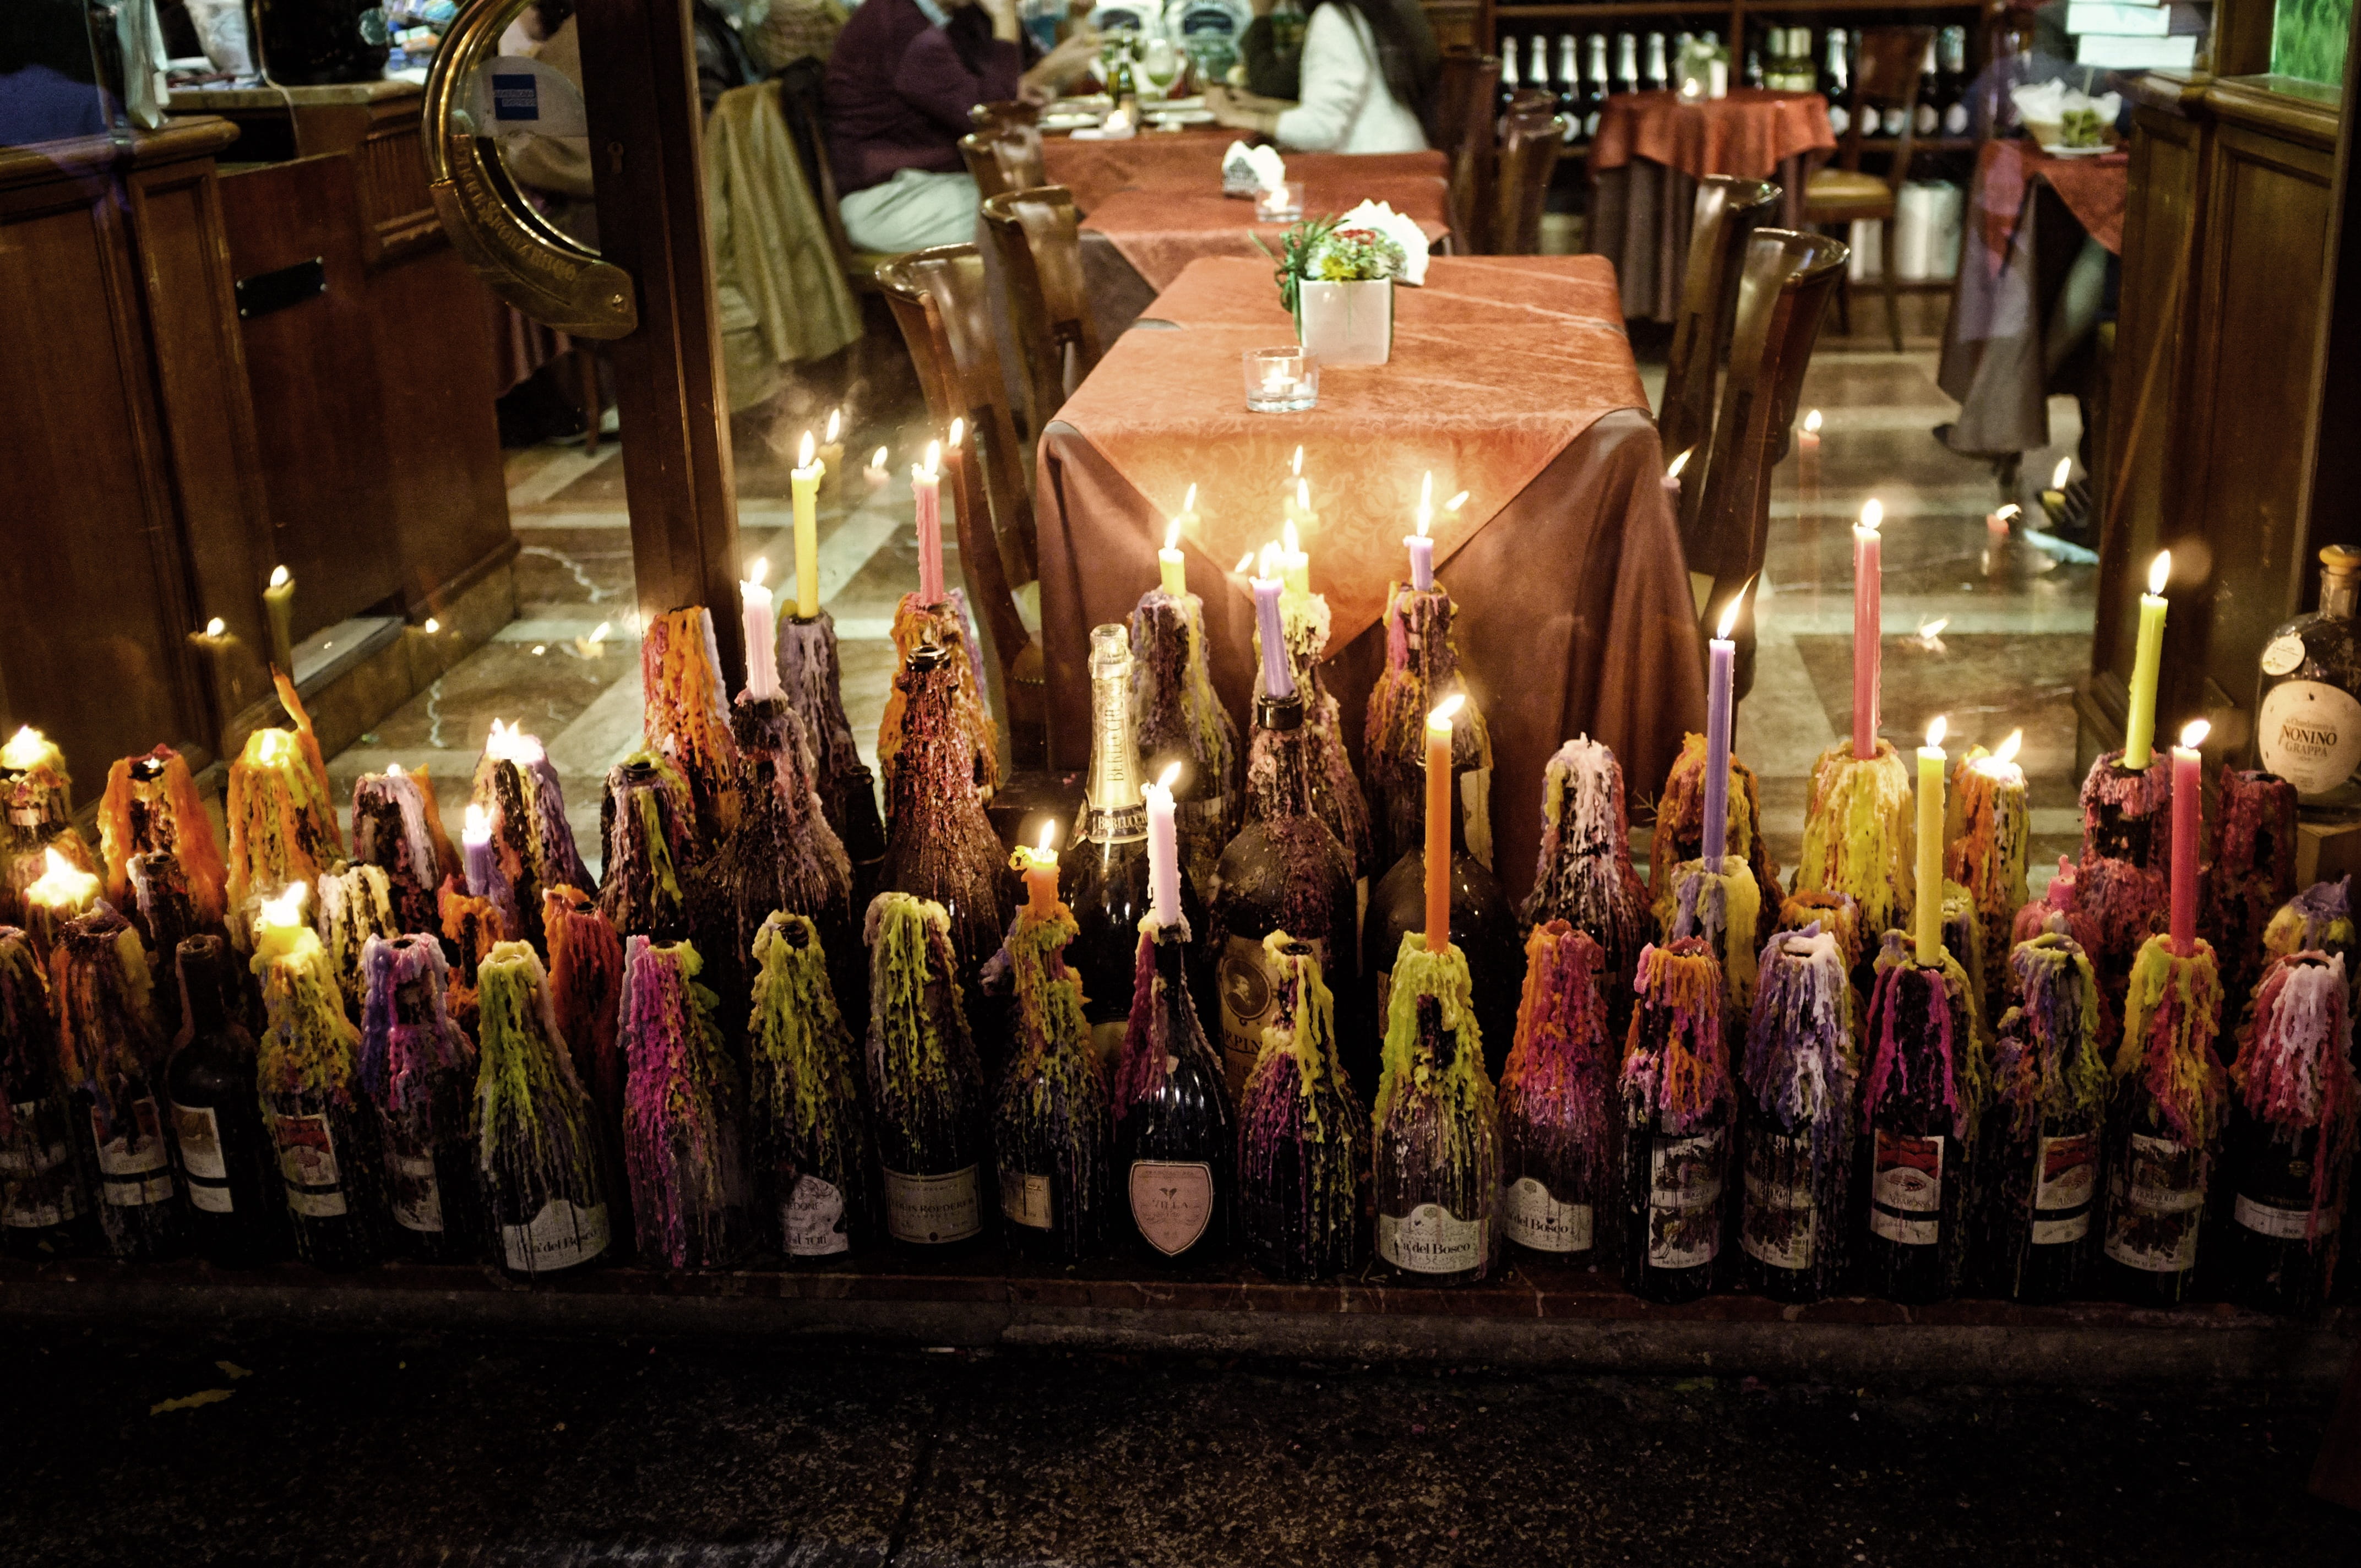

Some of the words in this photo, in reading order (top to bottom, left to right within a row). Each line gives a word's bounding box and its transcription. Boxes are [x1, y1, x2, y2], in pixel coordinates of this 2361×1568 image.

[2278, 725, 2337, 746] NONINO
[1104, 709, 1124, 781] BERLUCCHI
[2286, 743, 2327, 757] GRAPPA
[1097, 811, 1147, 830] BERLUCCH
[1531, 1218, 1569, 1234] Bosco
[1433, 1242, 1471, 1255] Bosco
